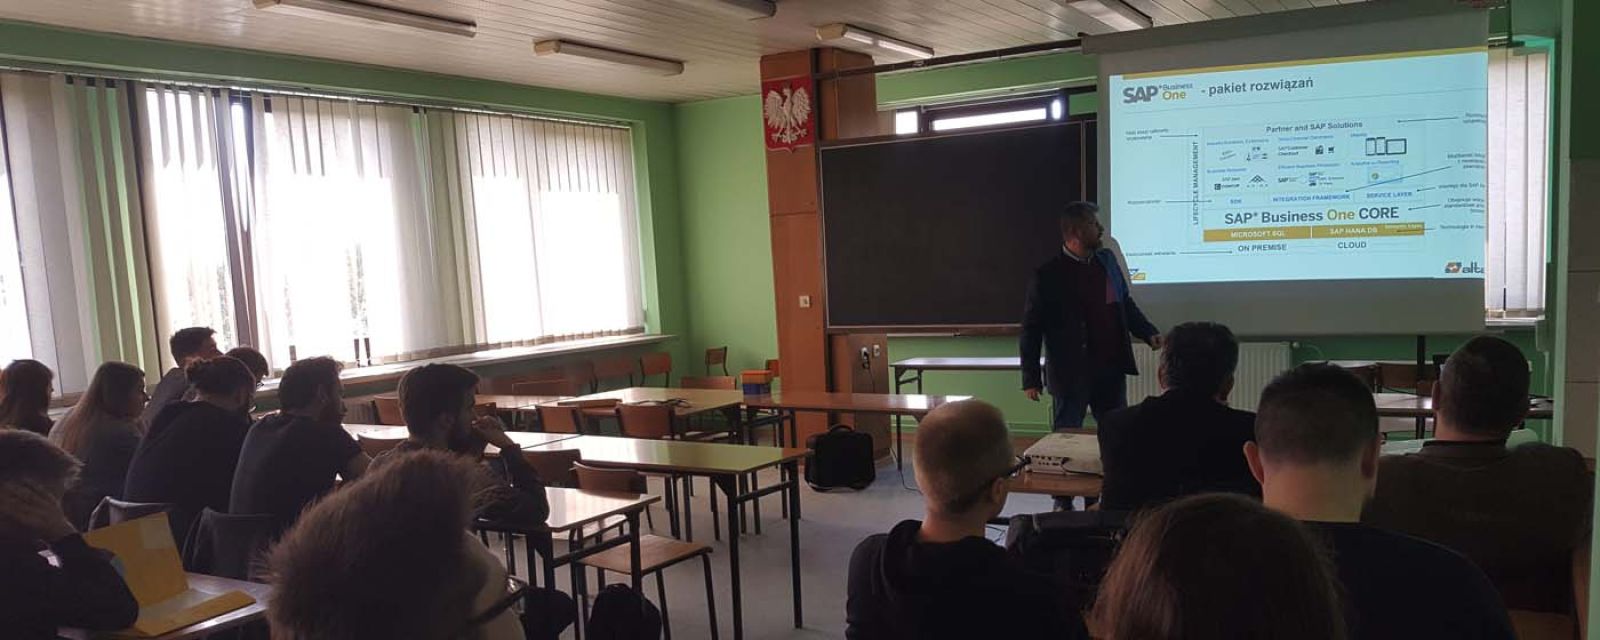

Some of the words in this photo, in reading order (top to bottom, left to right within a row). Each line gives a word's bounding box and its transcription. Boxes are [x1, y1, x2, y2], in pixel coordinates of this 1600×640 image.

[1162, 82, 1193, 91] Business
[1209, 84, 1247, 97] pakiet
[1249, 77, 1314, 92] rozwiązań
[1162, 90, 1186, 100] One
[1328, 121, 1363, 129] Solutions
[1261, 210, 1323, 223] Business
[1327, 208, 1355, 220] One
[1359, 206, 1399, 220] CORE
[1231, 231, 1272, 239] MICROSOFT
[1251, 243, 1287, 251] PREMISE
